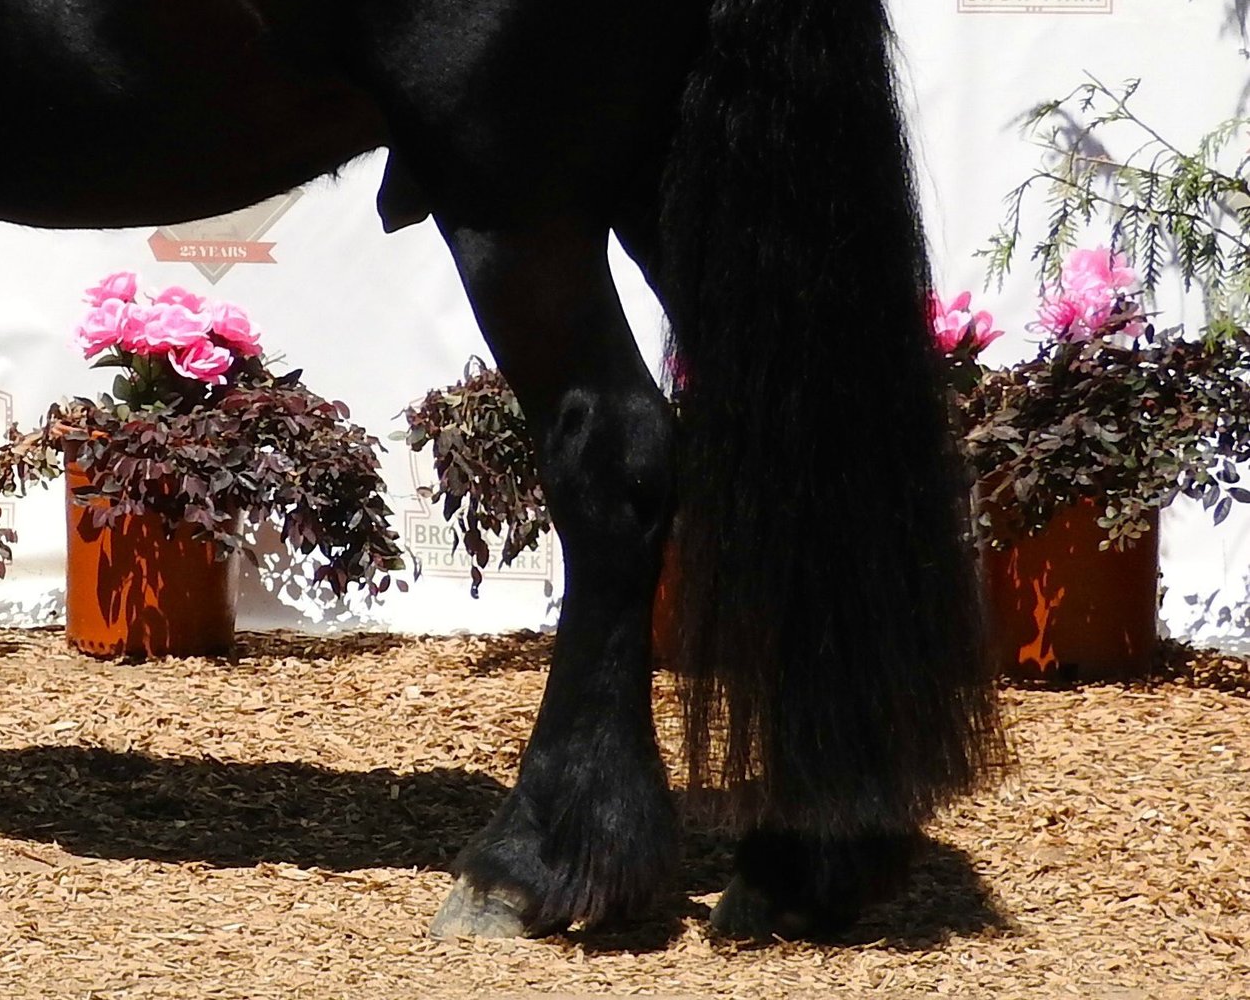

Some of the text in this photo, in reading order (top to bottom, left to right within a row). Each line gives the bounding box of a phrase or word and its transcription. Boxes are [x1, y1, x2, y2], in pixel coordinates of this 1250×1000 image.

[180, 245, 248, 258] 25 YEARS
[487, 552, 542, 569] PRK
